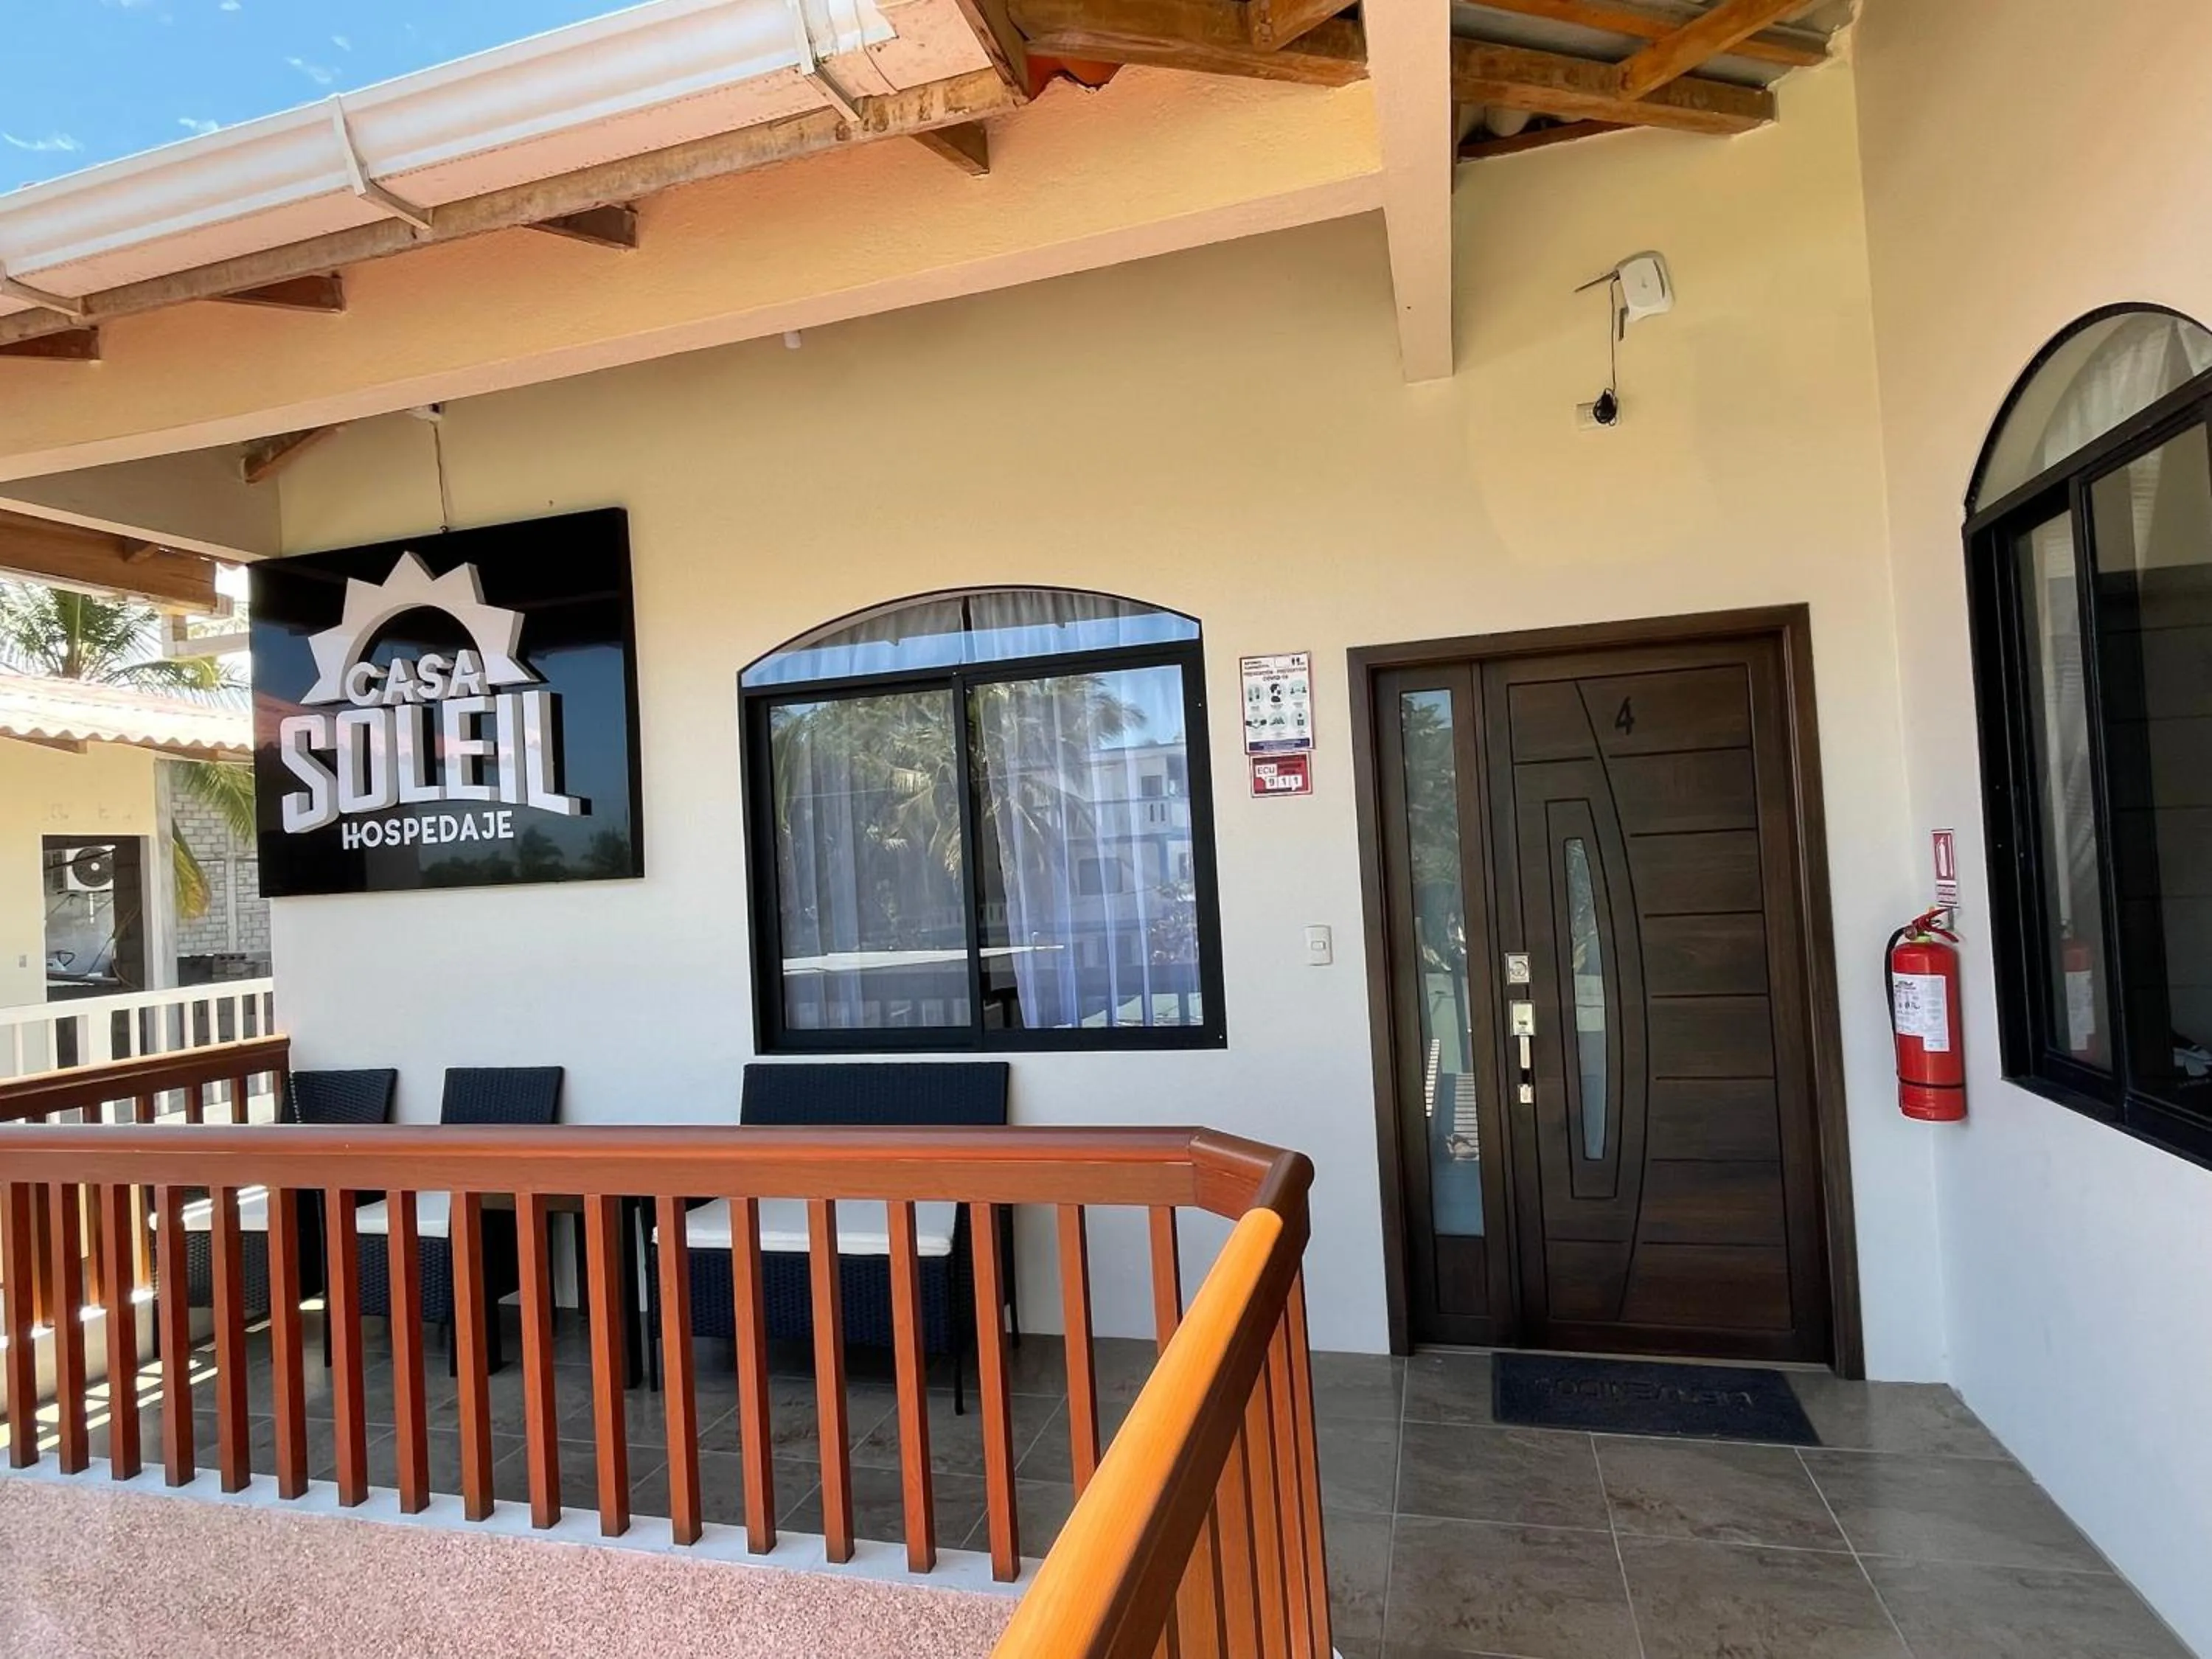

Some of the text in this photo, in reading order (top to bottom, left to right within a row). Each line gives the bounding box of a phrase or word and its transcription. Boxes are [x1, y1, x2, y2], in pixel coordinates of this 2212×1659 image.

[345, 649, 484, 707] CASA
[1614, 696, 1635, 736] 4
[279, 690, 575, 834] SOLEIL
[1257, 766, 1275, 775] ECU
[1269, 776, 1298, 787] 911
[341, 811, 515, 850] HOSPEDAJE
